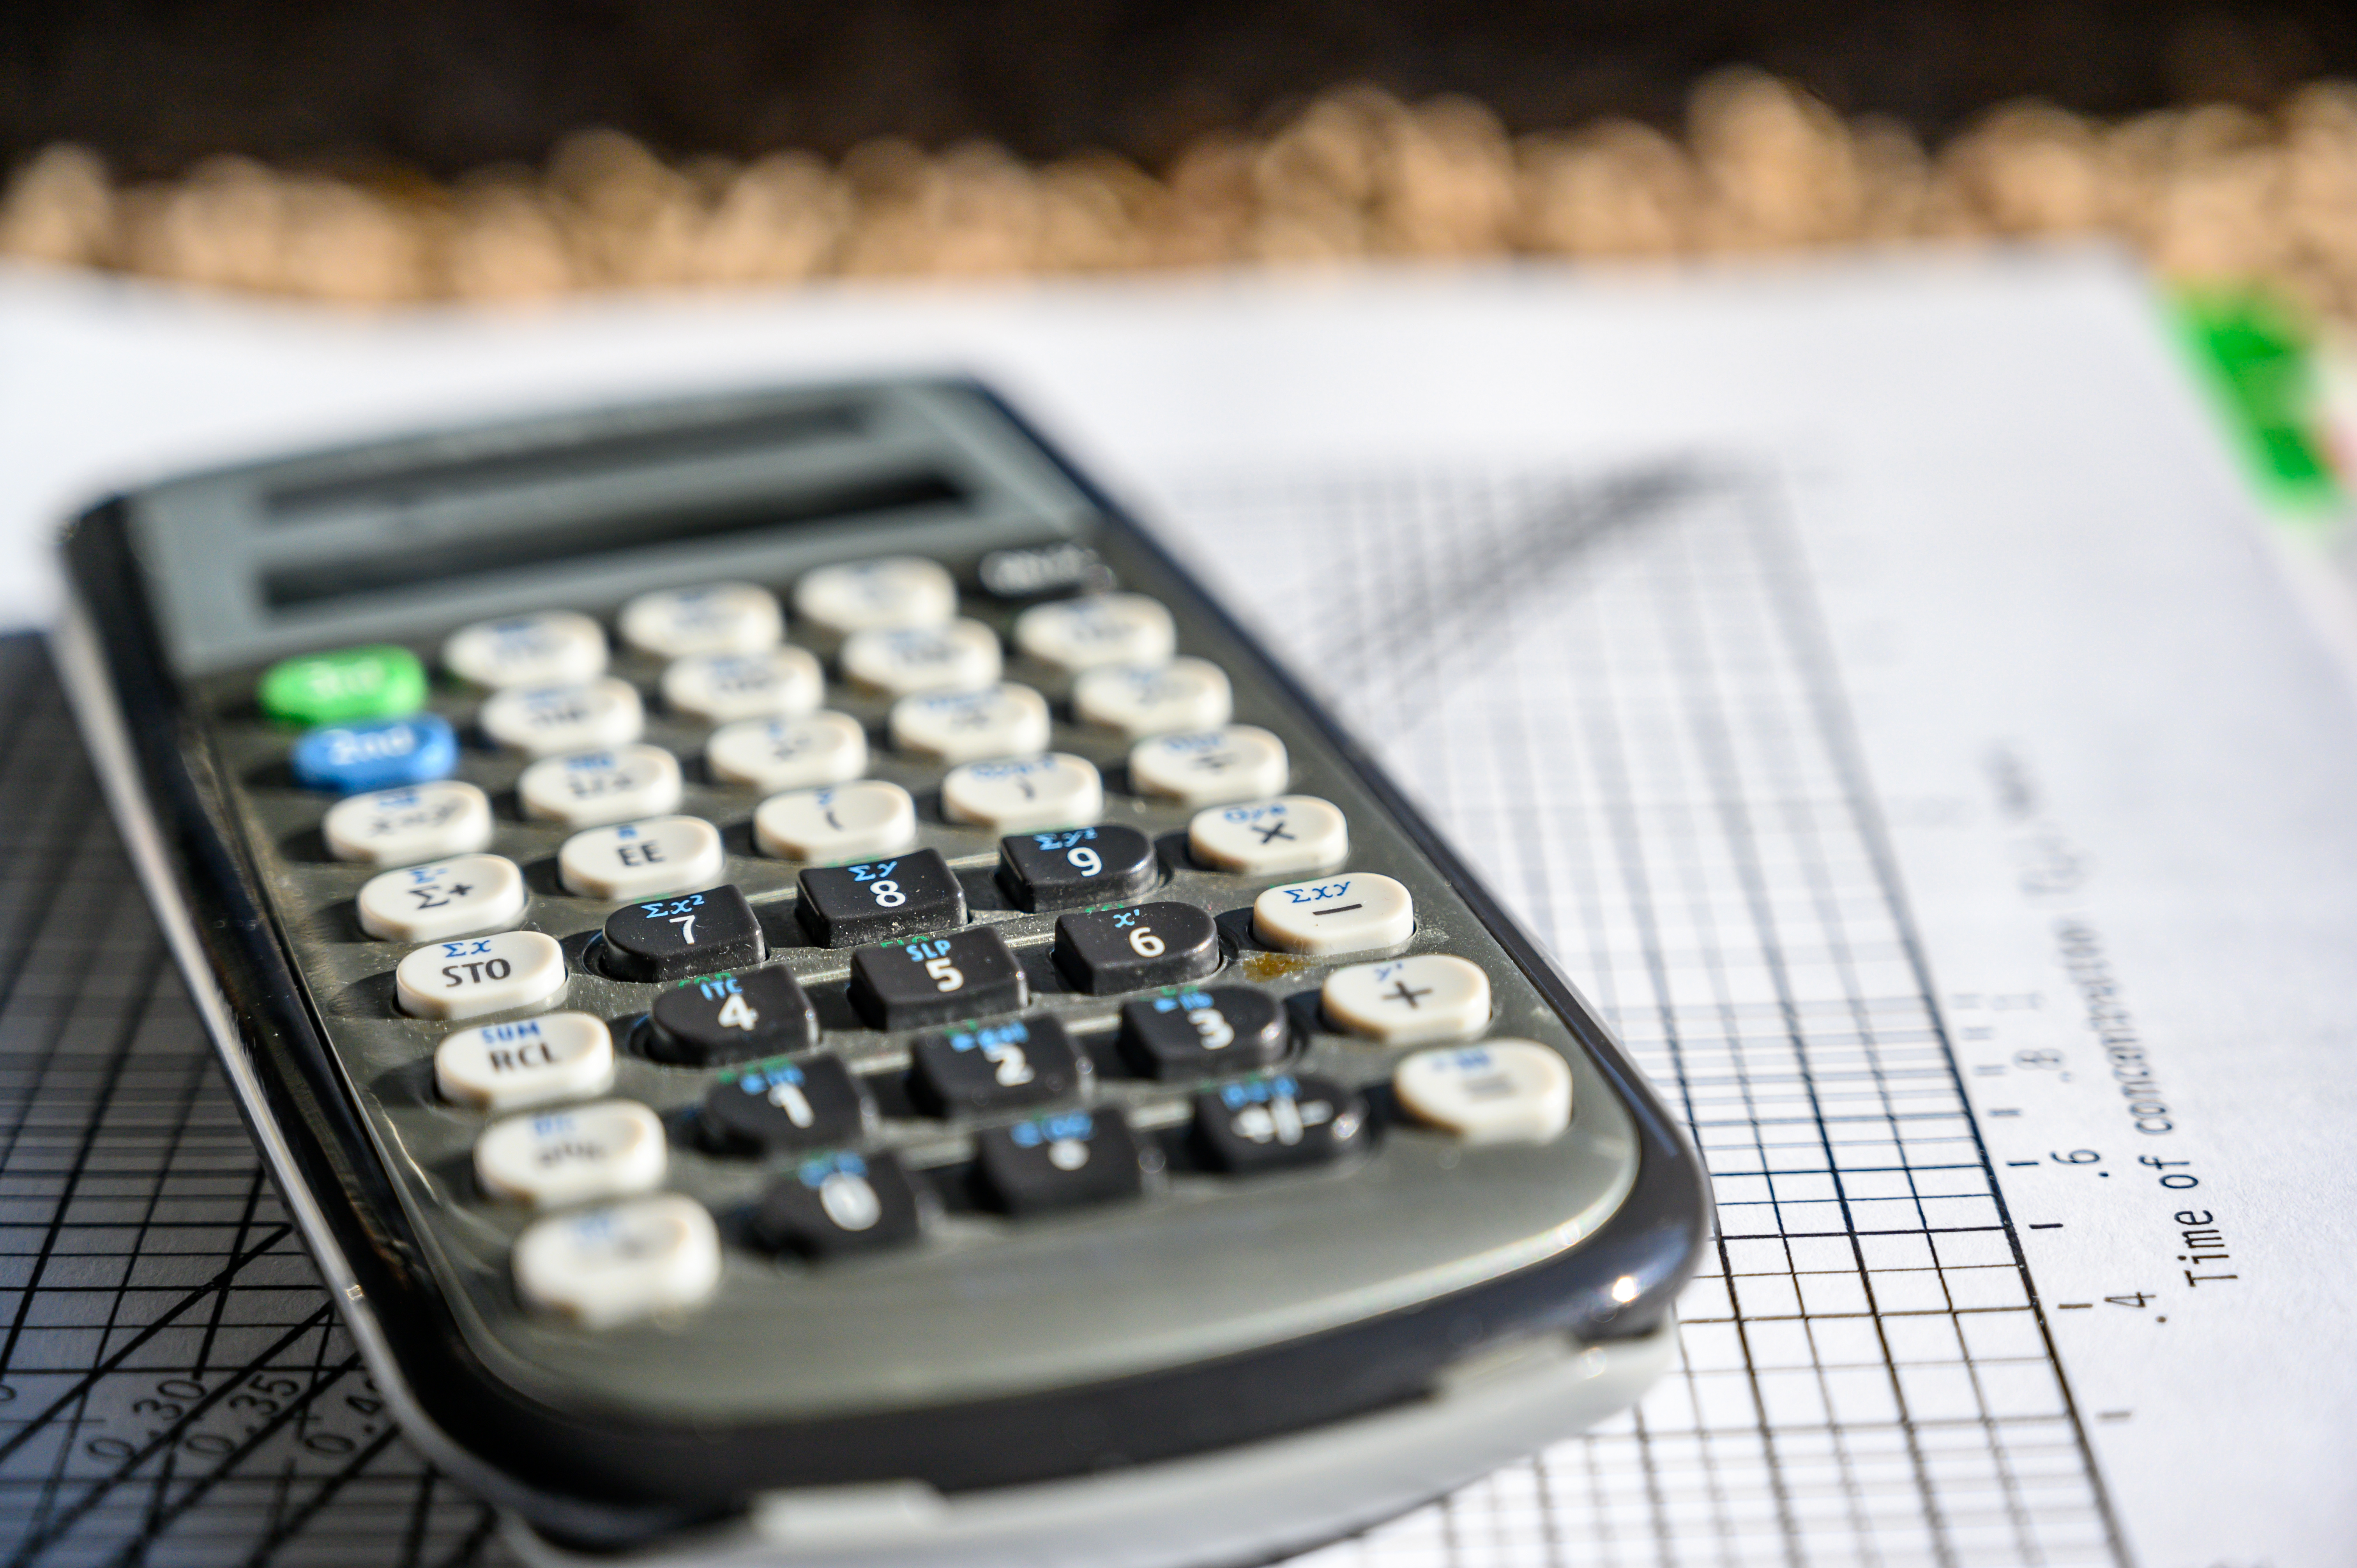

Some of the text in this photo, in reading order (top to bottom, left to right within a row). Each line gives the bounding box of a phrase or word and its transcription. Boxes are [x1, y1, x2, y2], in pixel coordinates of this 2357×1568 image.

[617, 840, 666, 867] EE
[1067, 847, 1102, 877] 9
[869, 880, 906, 907] 8
[668, 915, 696, 945] 7
[1129, 926, 1166, 957] 6
[906, 939, 951, 962] SLP
[442, 958, 511, 988] STO
[699, 976, 742, 1001] ITC
[925, 957, 964, 992] 5
[717, 992, 759, 1031] 4
[479, 1020, 541, 1045] SUM
[1187, 1008, 1235, 1050] 3
[488, 1041, 562, 1074] RCL
[983, 1043, 1036, 1087] 2
[768, 1082, 815, 1129] 1
[2049, 1149, 2110, 1178] .6
[2138, 1154, 2199, 1189] of
[2173, 1209, 2239, 1287] Time
[2103, 1291, 2168, 1323] .4
[86, 1379, 207, 1458] 0.30
[184, 1374, 300, 1454] 0.35
[304, 1377, 386, 1455] 0.4
